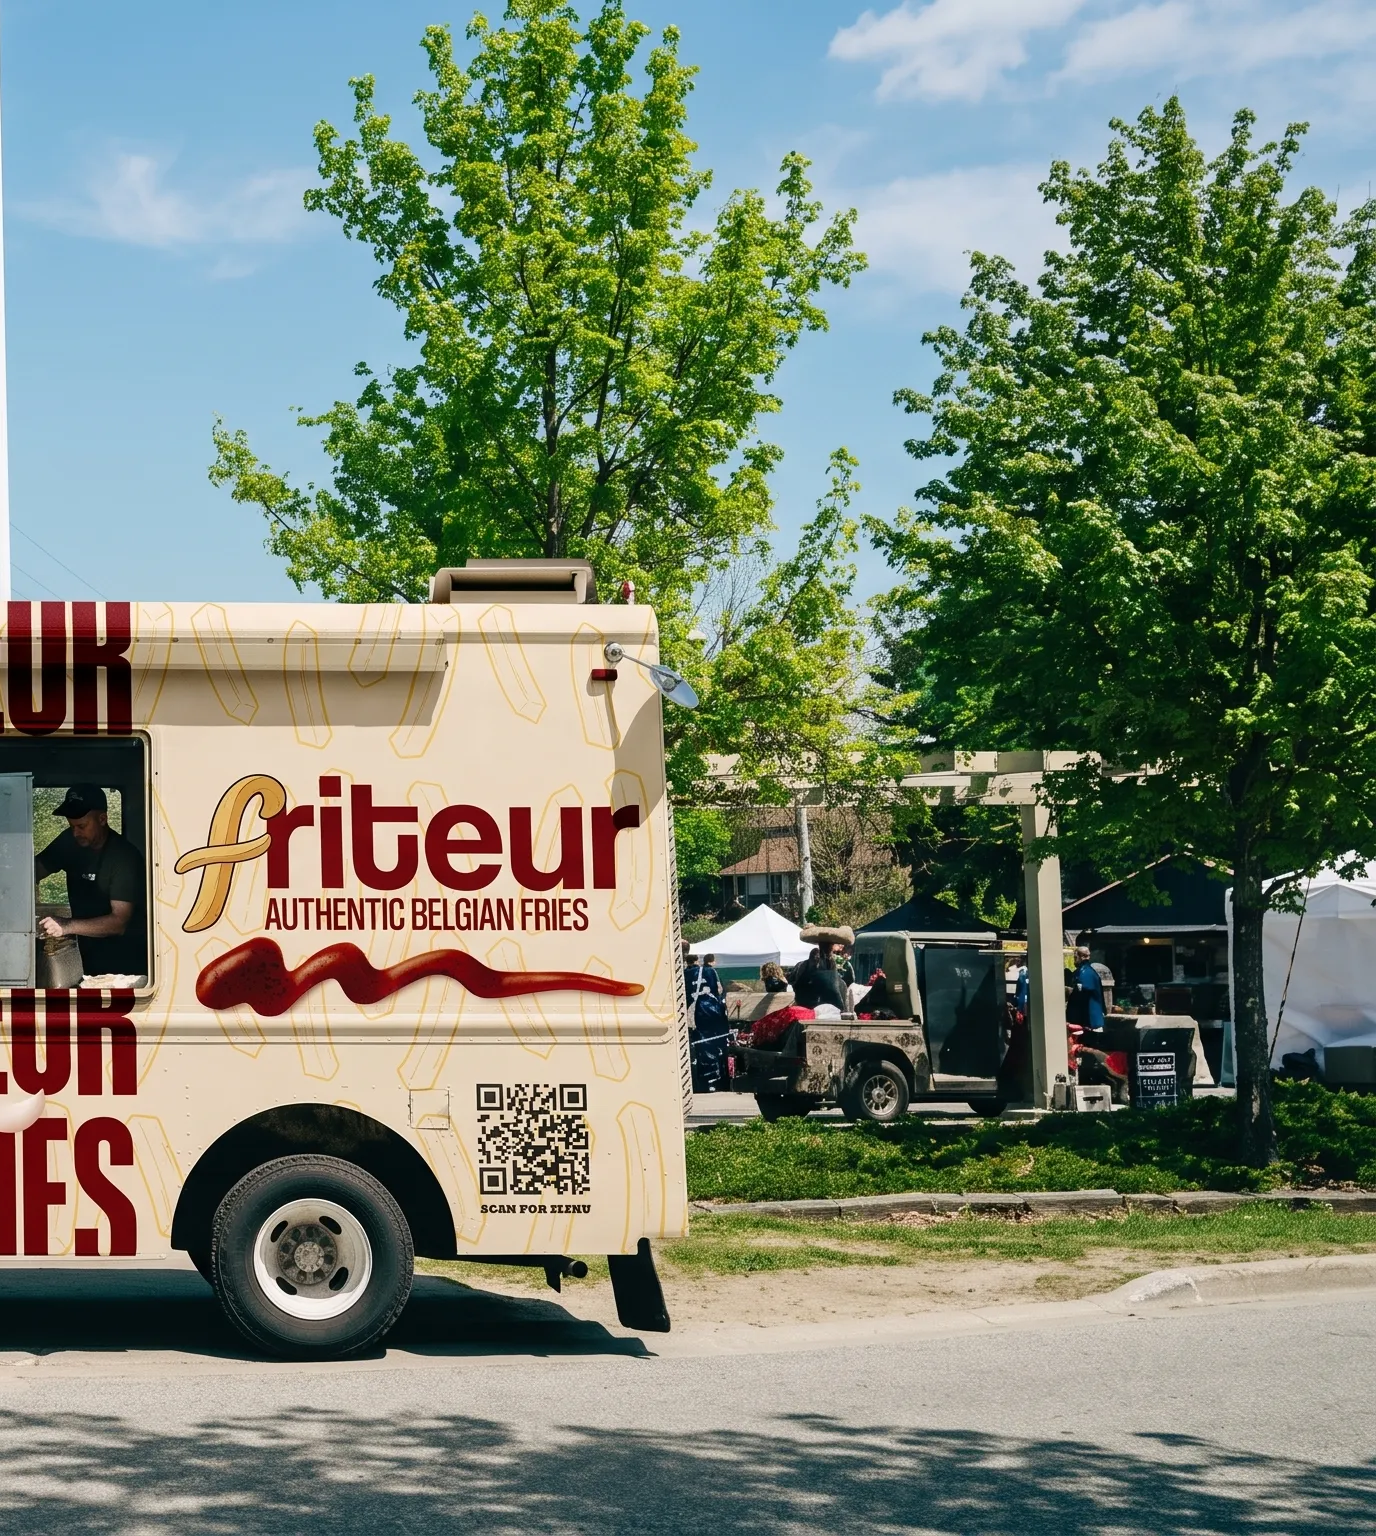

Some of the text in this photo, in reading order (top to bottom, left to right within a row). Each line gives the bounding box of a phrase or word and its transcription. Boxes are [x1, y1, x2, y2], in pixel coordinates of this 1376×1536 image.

[173, 773, 640, 933] friteur
[265, 897, 589, 931] AUTHENTIC BELGIAN FRIES
[480, 1204, 517, 1214] SCAN
[519, 1204, 548, 1214] FOR
